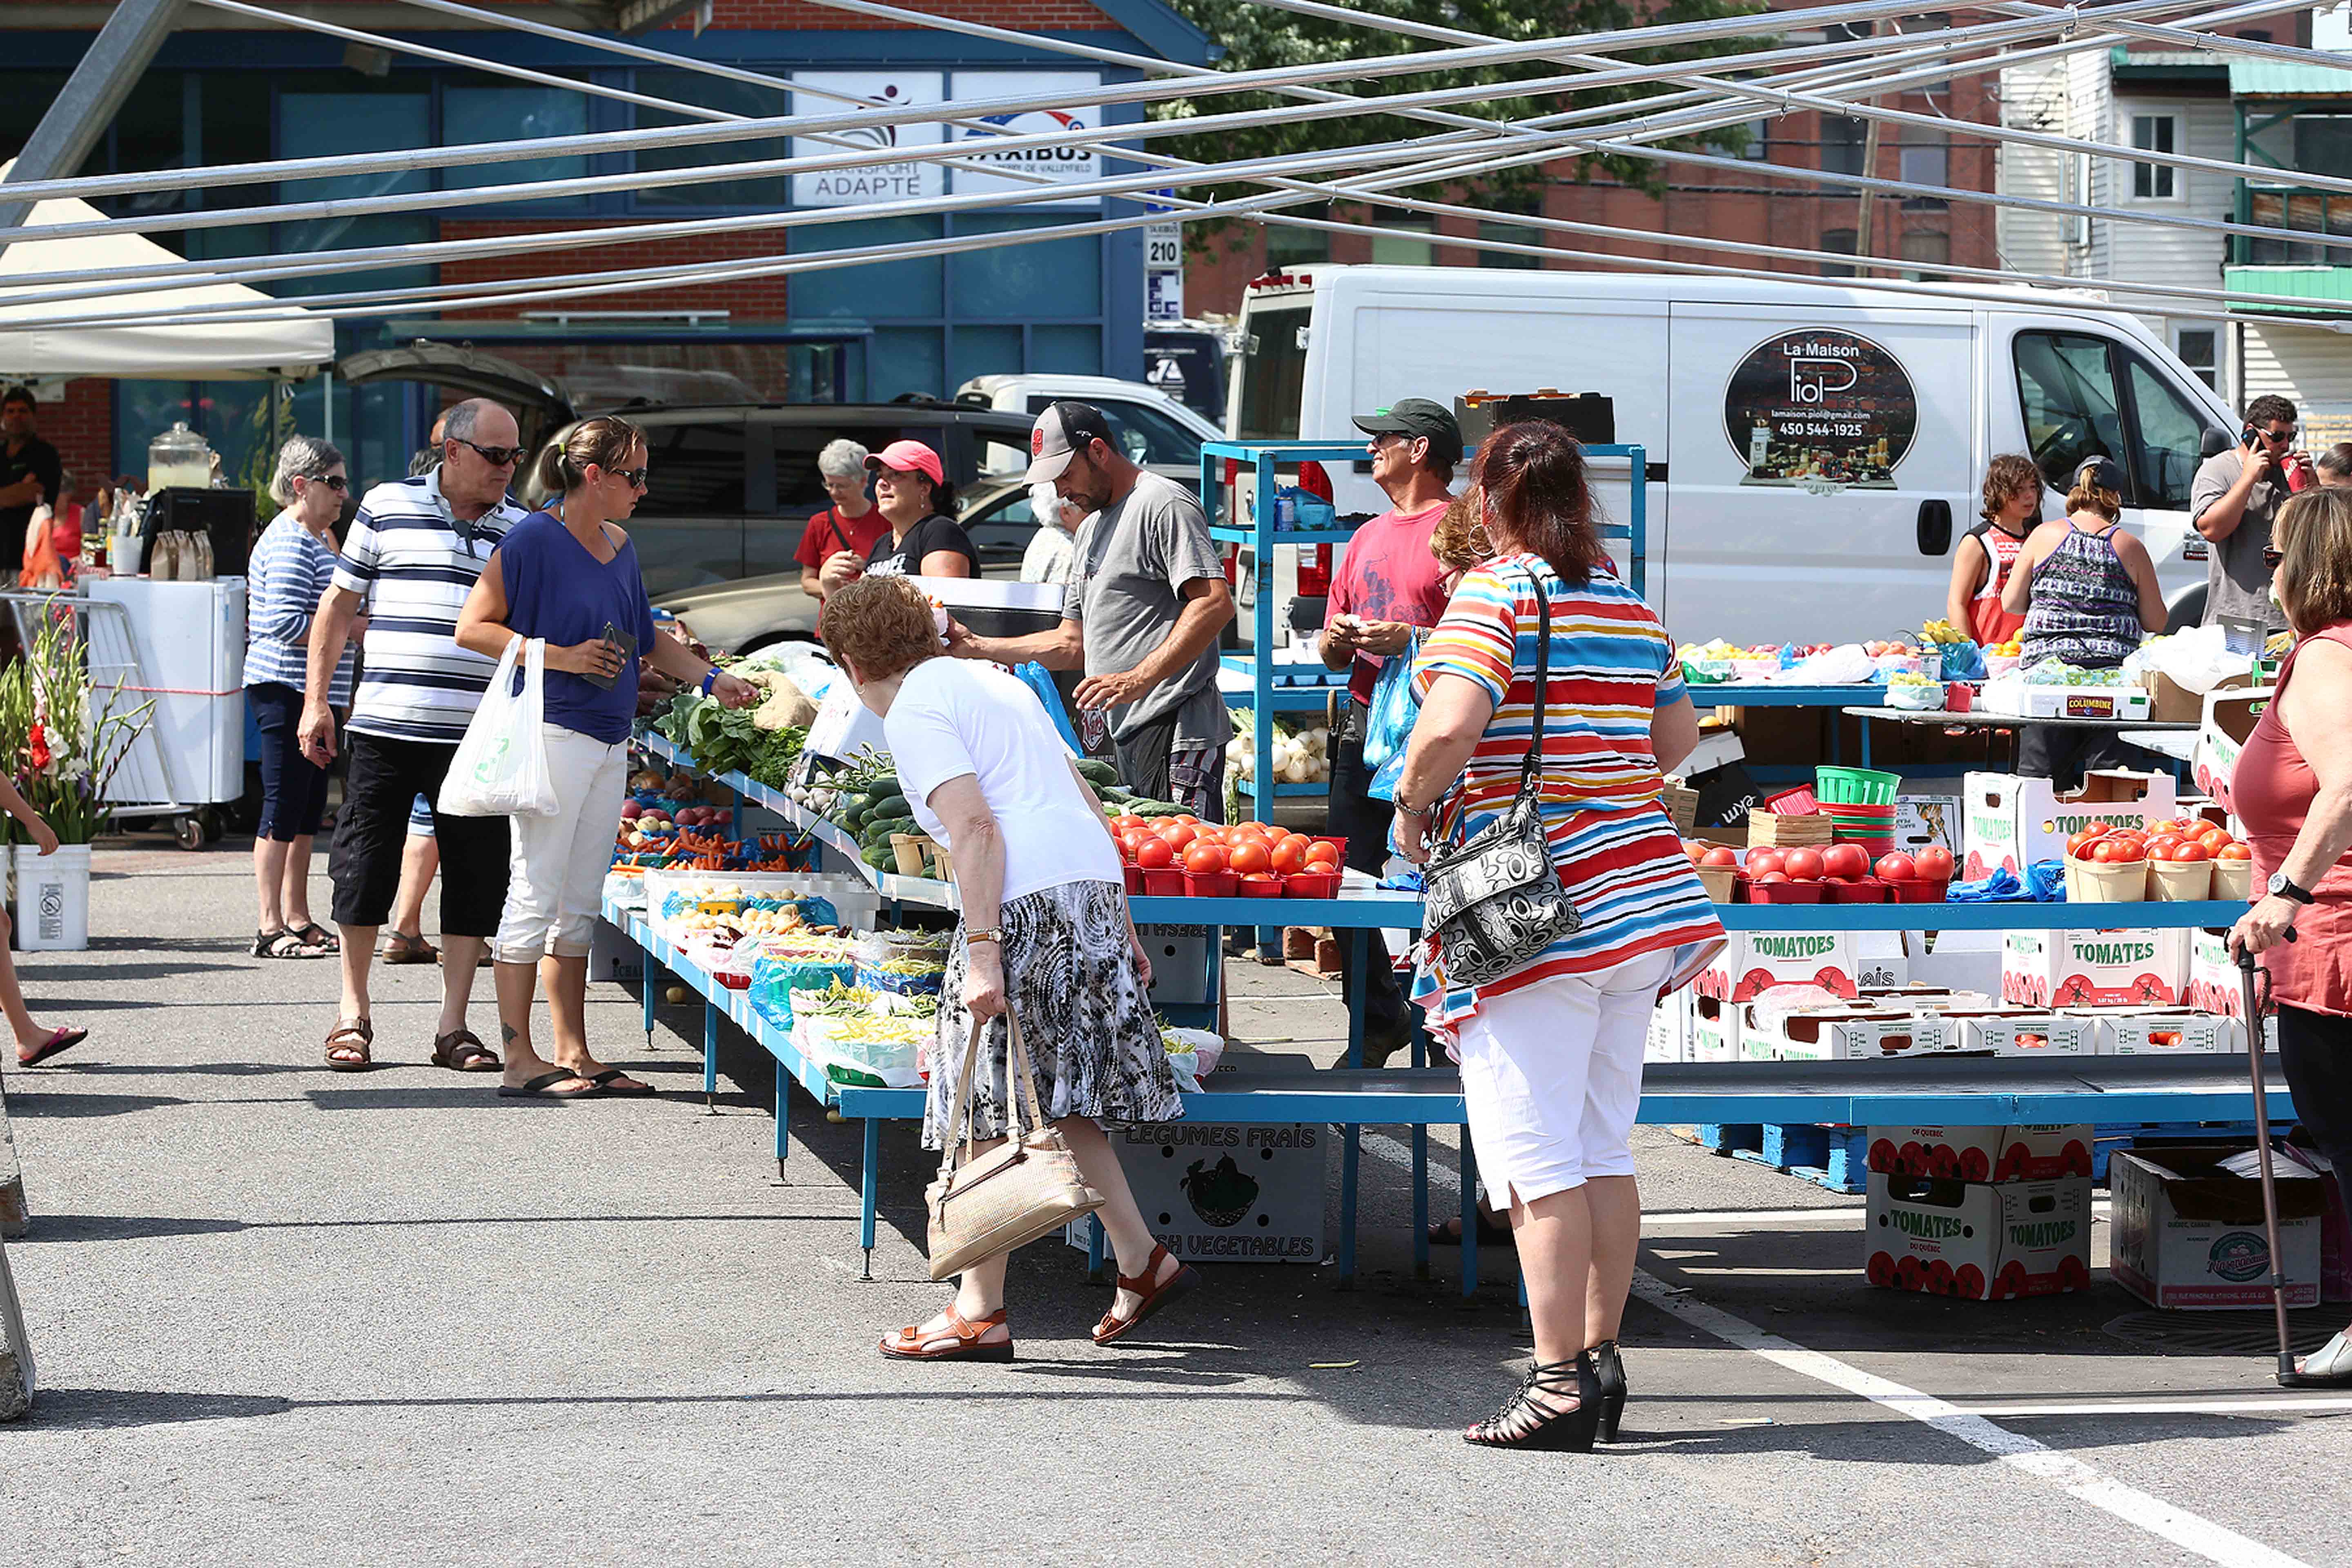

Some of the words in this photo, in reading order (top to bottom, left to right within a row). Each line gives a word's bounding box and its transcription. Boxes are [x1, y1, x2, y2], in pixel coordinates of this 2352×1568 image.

[815, 174, 920, 196] ADAPTÉ
[1150, 242, 1176, 261] 210
[1784, 343, 1800, 356] La
[1806, 343, 1859, 357] Maison
[1771, 410, 1870, 420] lamaison.piol@gmail.com
[1780, 423, 1803, 435] 450
[1806, 423, 1862, 436] 544-1925
[2056, 815, 2144, 835] TOMTOES
[1753, 935, 1835, 957] TOMATOES
[2073, 942, 2154, 964] TOMATES
[1890, 1209, 1962, 1238] TOMATES
[2009, 1221, 2076, 1247] TOMATOES
[1187, 1236, 1314, 1257] VEGETABLES
[1910, 1242, 1918, 1251] DU
